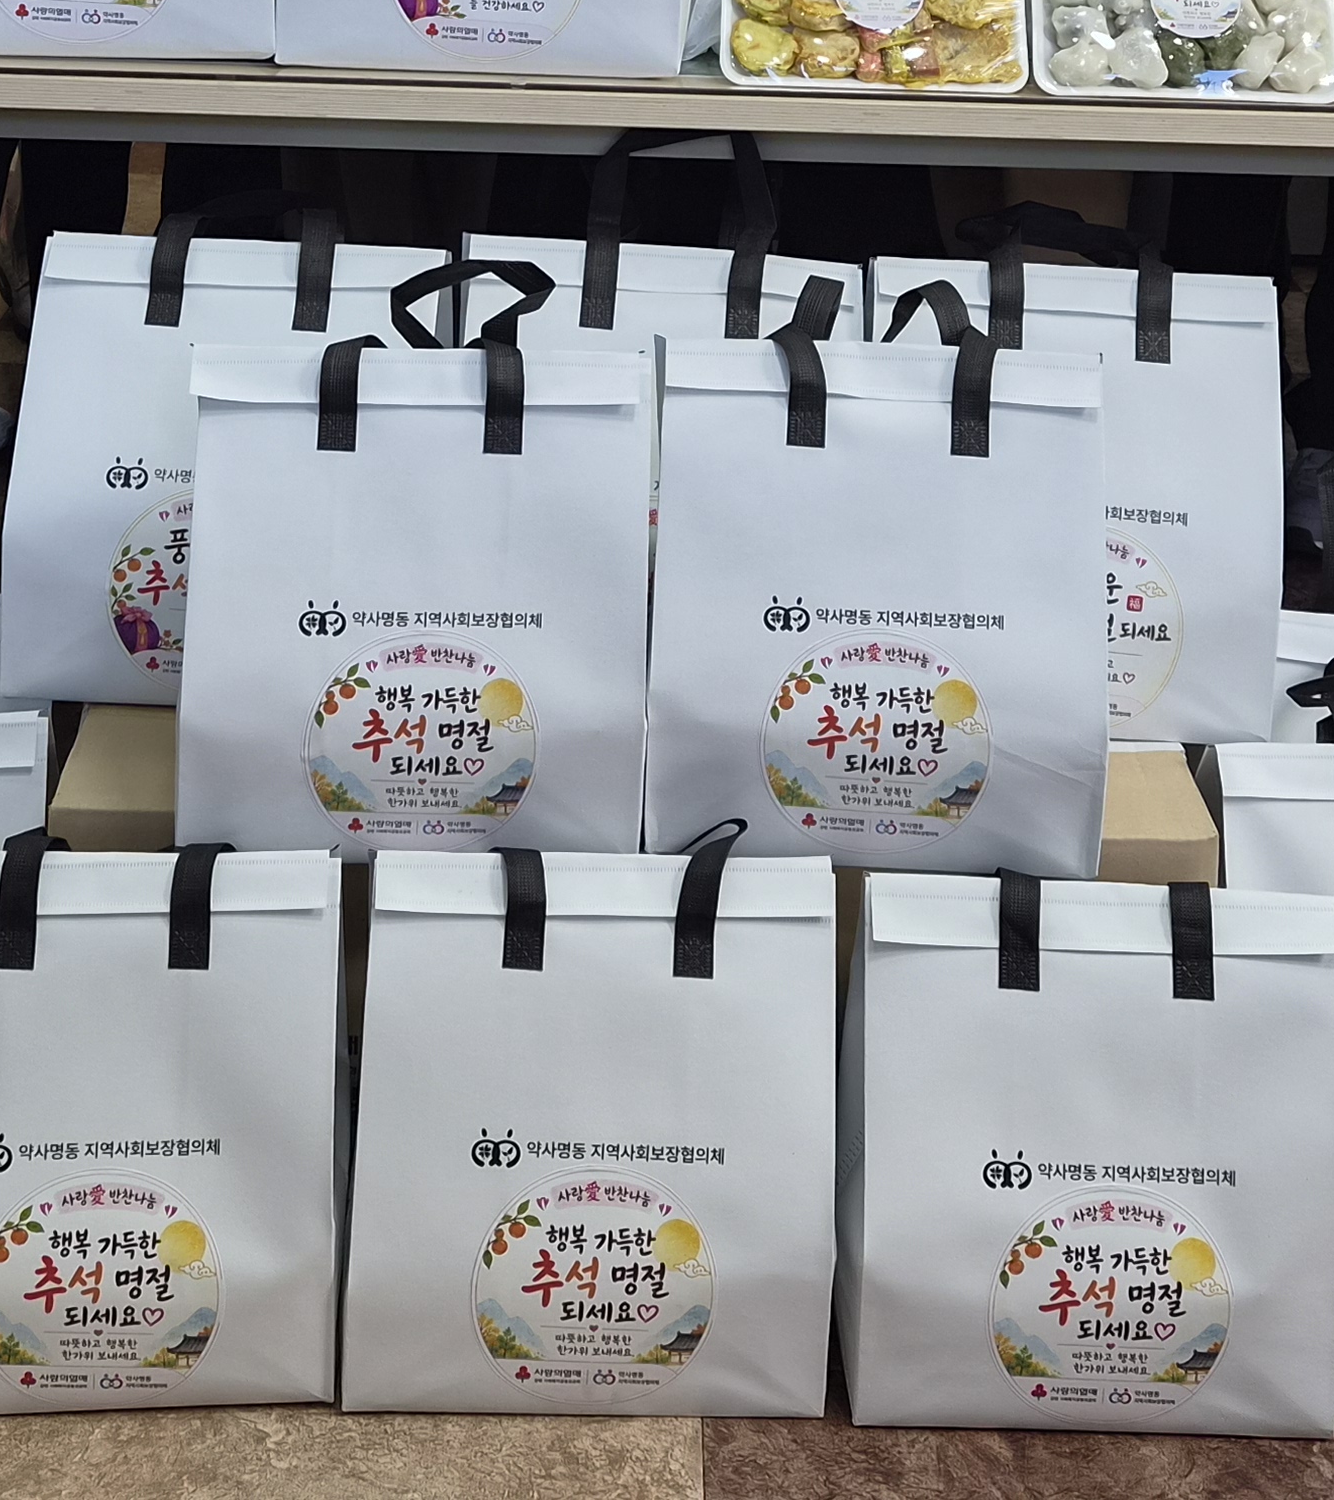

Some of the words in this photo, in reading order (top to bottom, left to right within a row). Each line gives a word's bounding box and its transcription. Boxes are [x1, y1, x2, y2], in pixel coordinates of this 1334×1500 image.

[815, 606, 873, 626] 약사명동
[876, 609, 1006, 631] 지역사회보장협의체
[806, 704, 882, 760] 추석
[892, 718, 948, 754] 명절
[18, 1141, 81, 1161] 약사명동
[84, 1137, 222, 1159] 지역사회보장협의체
[526, 1140, 587, 1161] 약사명동
[590, 1142, 726, 1165] 지역사회보장협의체
[557, 1180, 601, 1203] 사랑愛
[603, 1185, 652, 1208] 반찬나눔
[545, 1224, 588, 1255] 행복
[593, 1227, 657, 1257] 가득한
[23, 1254, 104, 1313] 추석
[115, 1264, 175, 1302] 명절
[521, 1248, 600, 1308] 추석
[611, 1261, 670, 1298] 명절
[1038, 1268, 1117, 1327] 추석
[1127, 1280, 1187, 1318] 명절
[63, 1305, 142, 1327] 되세요
[559, 1300, 637, 1324] 되세요
[554, 1333, 598, 1344] 따뜻하고
[600, 1333, 633, 1345] 행복한
[556, 1344, 590, 1358] 한가위
